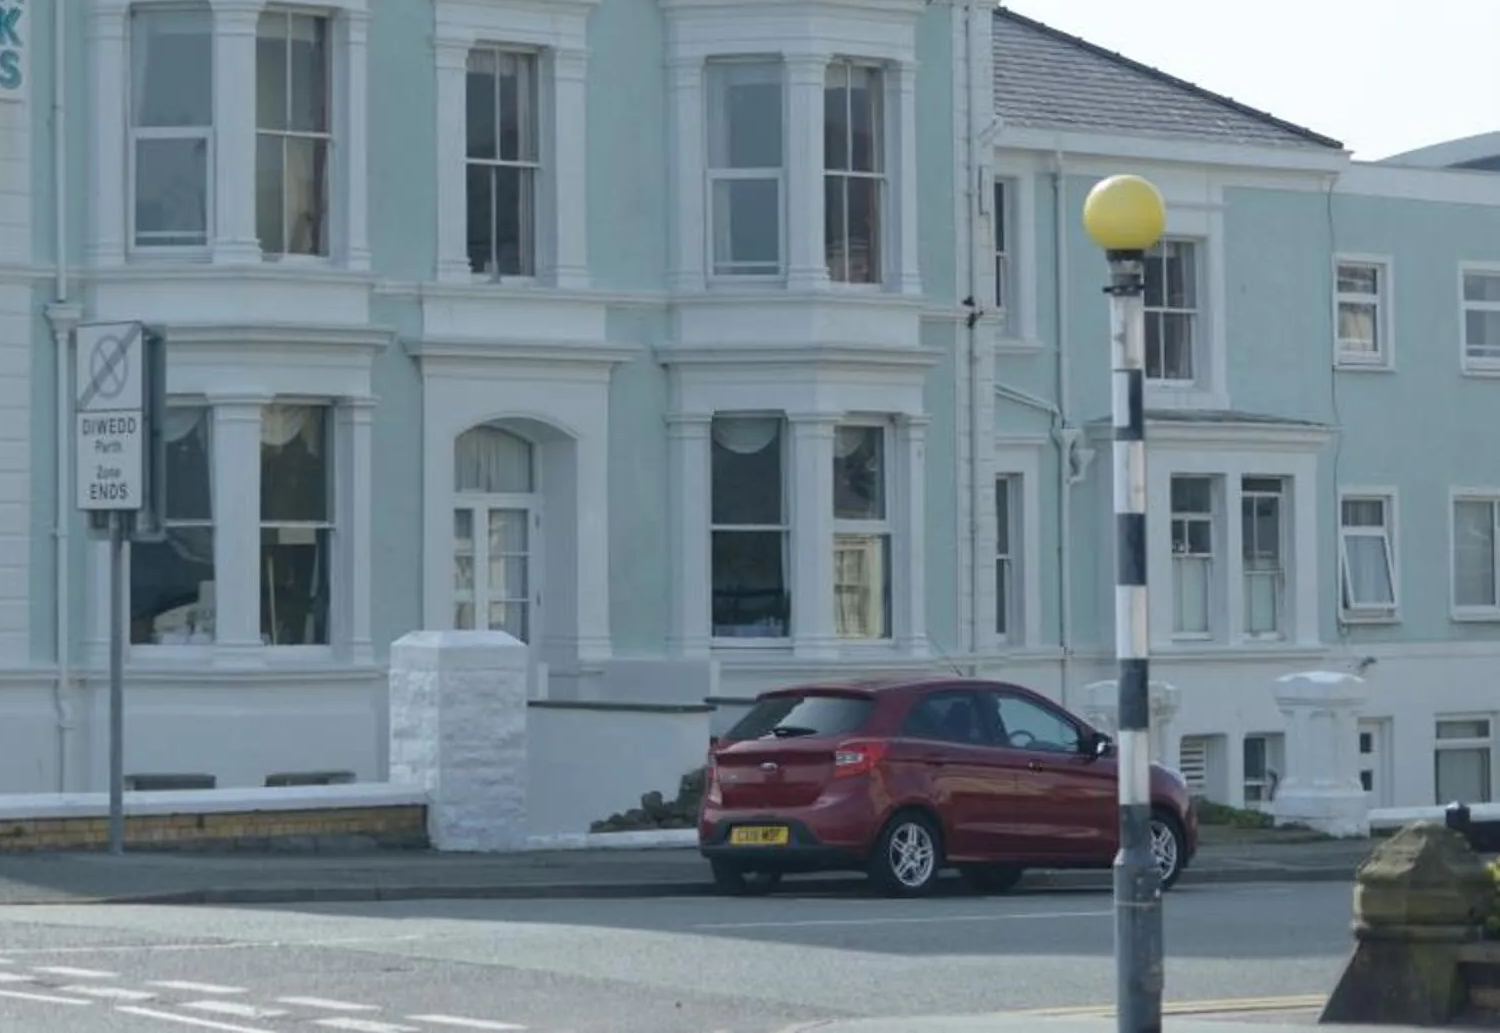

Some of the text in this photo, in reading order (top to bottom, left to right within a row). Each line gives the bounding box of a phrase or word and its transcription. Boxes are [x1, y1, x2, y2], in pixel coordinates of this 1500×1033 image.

[82, 418, 137, 436] DIWEDD
[95, 439, 123, 453] Parth
[96, 465, 122, 479] Zone
[90, 483, 128, 500] ENDS
